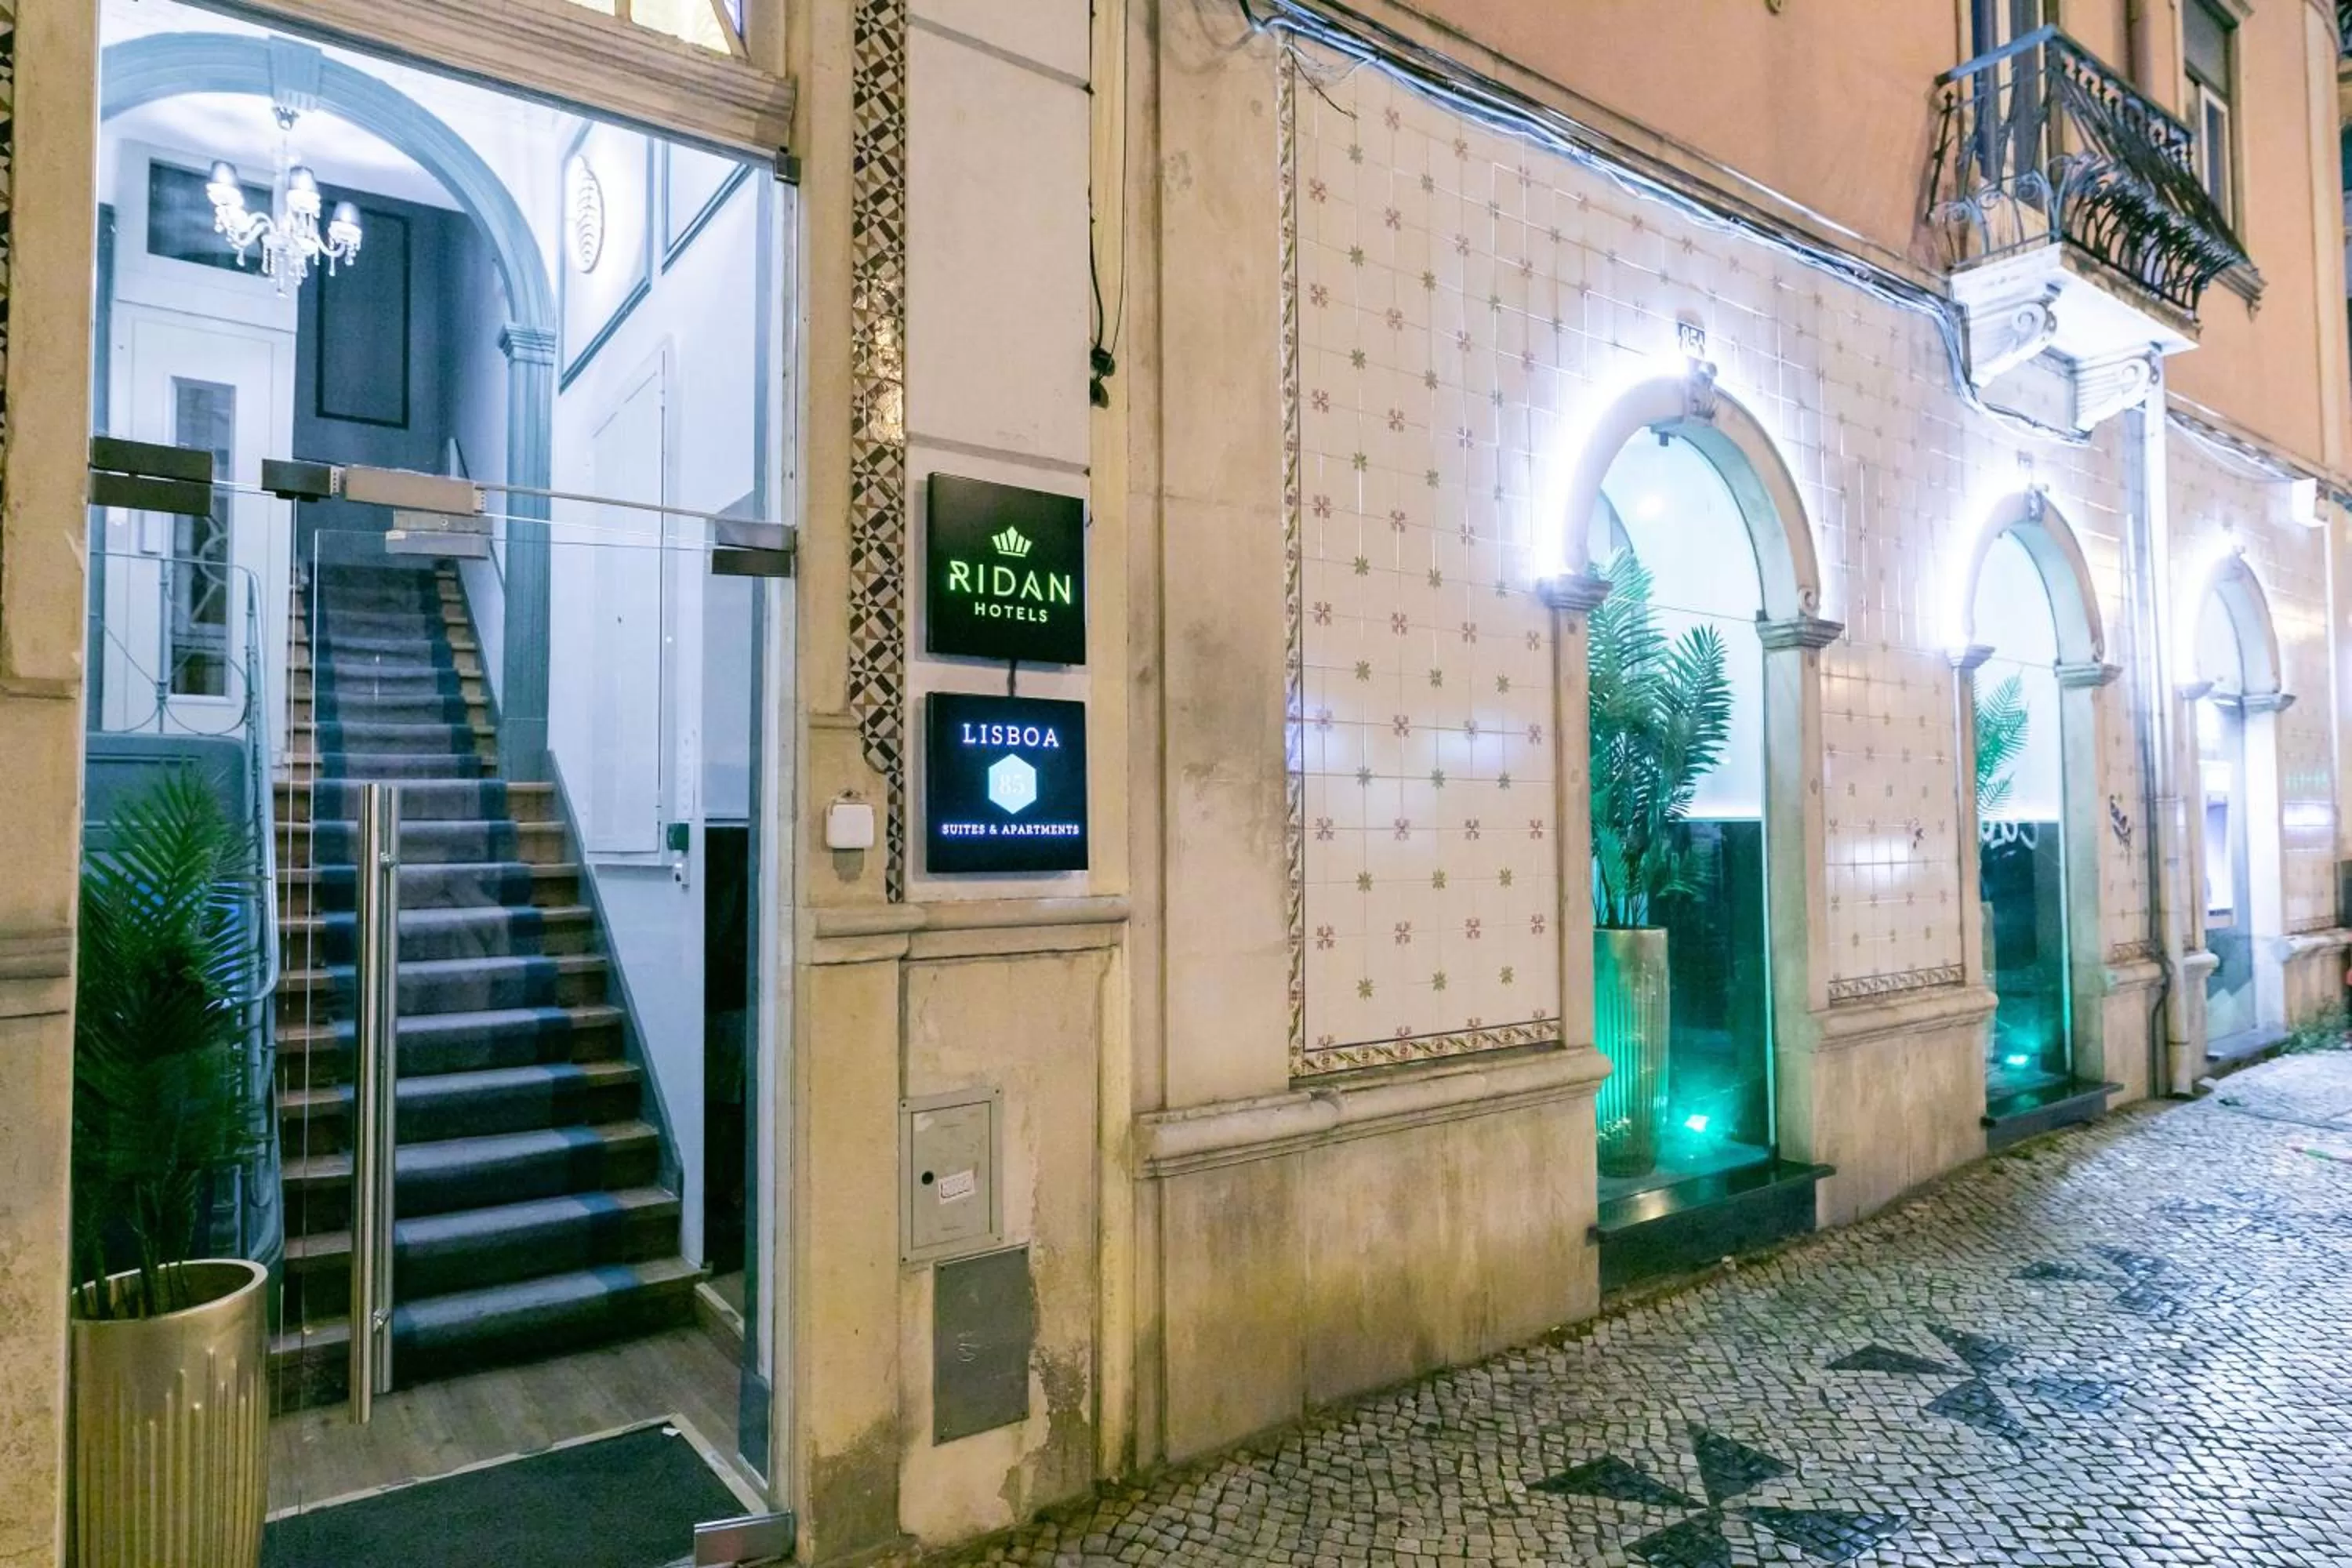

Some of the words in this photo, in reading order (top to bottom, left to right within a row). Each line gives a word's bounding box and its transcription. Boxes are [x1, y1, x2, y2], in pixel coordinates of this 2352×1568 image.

[949, 560, 1071, 604] RIDAN
[975, 601, 1047, 623] HOTELS
[962, 722, 1059, 749] LISBOA
[998, 774, 1025, 795] 85
[942, 823, 985, 836] SUITES
[989, 824, 998, 836] &
[1001, 823, 1080, 836] APARTMENTS
